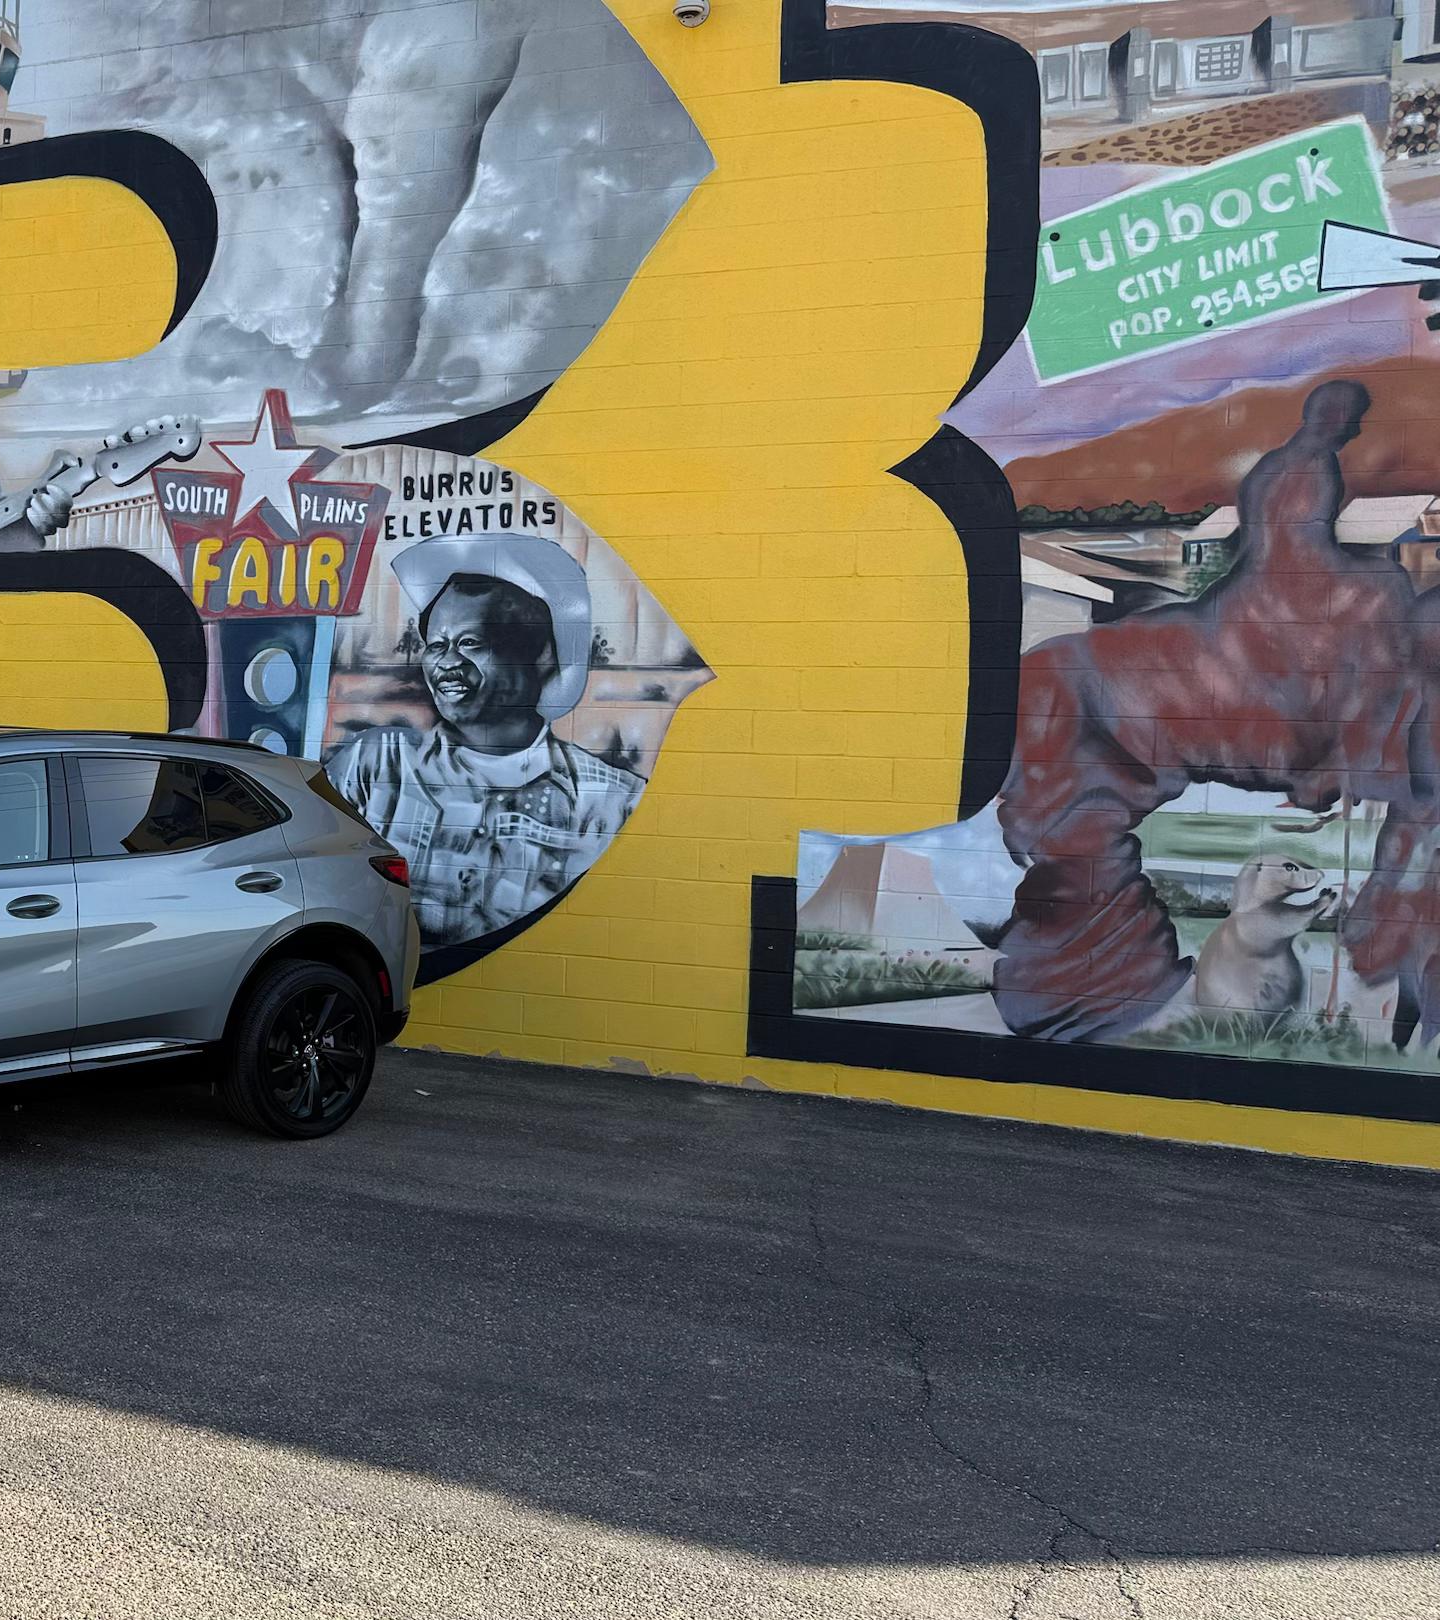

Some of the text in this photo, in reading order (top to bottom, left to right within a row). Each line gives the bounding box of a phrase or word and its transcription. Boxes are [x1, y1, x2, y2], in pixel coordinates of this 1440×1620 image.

[1041, 155, 1344, 286] Lubbock
[1109, 255, 1319, 350] POP. 254,565
[1117, 230, 1280, 304] CITY LIMIT
[164, 482, 369, 524] SOUTH PLAINS
[384, 500, 556, 541] ELEVATORS
[403, 471, 514, 503] BURRUS
[191, 536, 345, 610] FAIR
